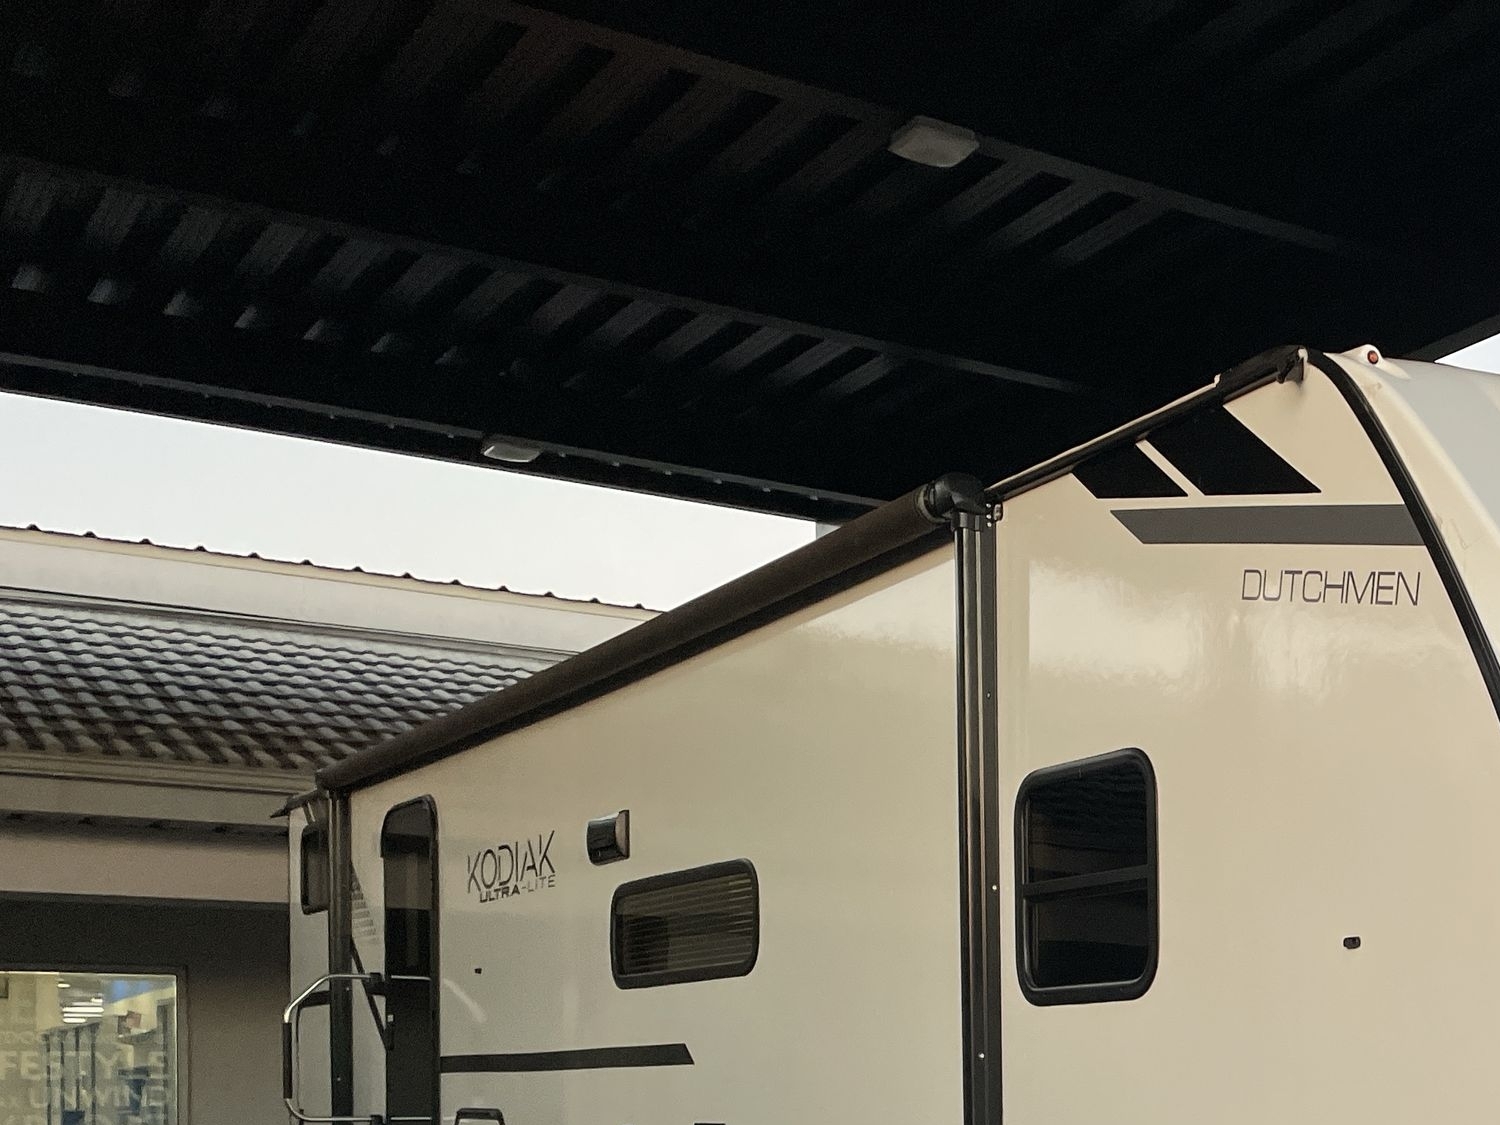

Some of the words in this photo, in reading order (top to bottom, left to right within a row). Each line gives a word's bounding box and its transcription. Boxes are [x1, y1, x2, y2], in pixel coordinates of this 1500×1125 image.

[1241, 569, 1421, 606] DUTCHMEN
[467, 830, 555, 893] KODIAK
[480, 875, 555, 903] ULTRA-LITE
